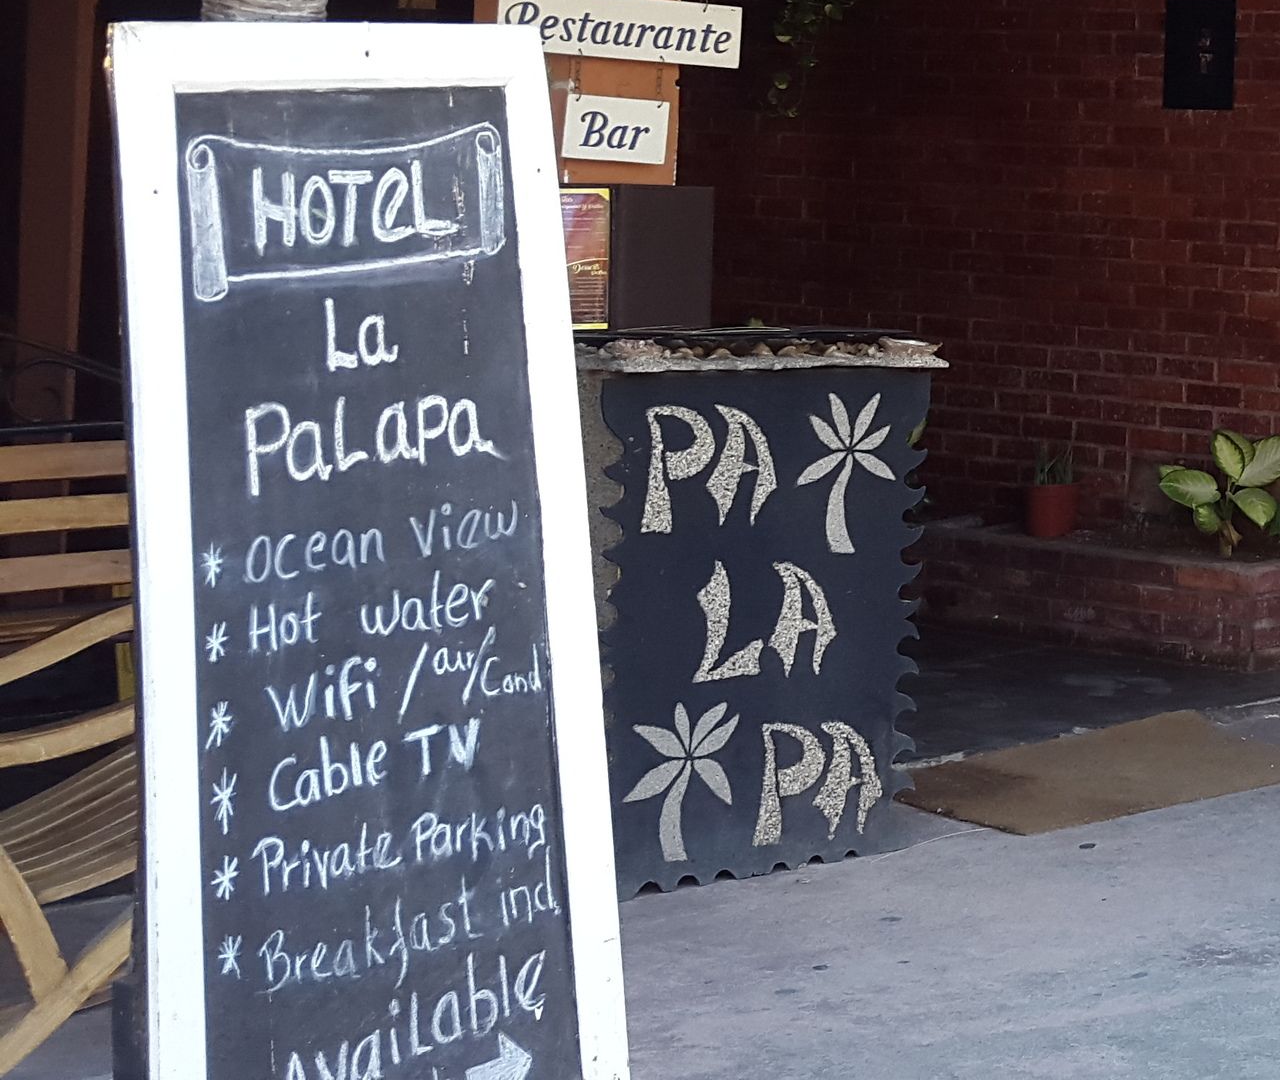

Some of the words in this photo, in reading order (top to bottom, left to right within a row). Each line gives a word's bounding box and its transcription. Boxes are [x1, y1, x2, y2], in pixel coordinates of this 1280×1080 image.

[504, 0, 733, 55] Restaurante
[578, 109, 651, 152] Bar
[323, 297, 399, 372] La
[640, 402, 779, 535] PA
[248, 590, 322, 653] Hot
[692, 559, 838, 684] LA
[403, 717, 481, 776] TV
[750, 720, 883, 848] PA
[250, 822, 402, 897] Private
[410, 803, 546, 862] Parking
[257, 875, 484, 999] Breakfast
